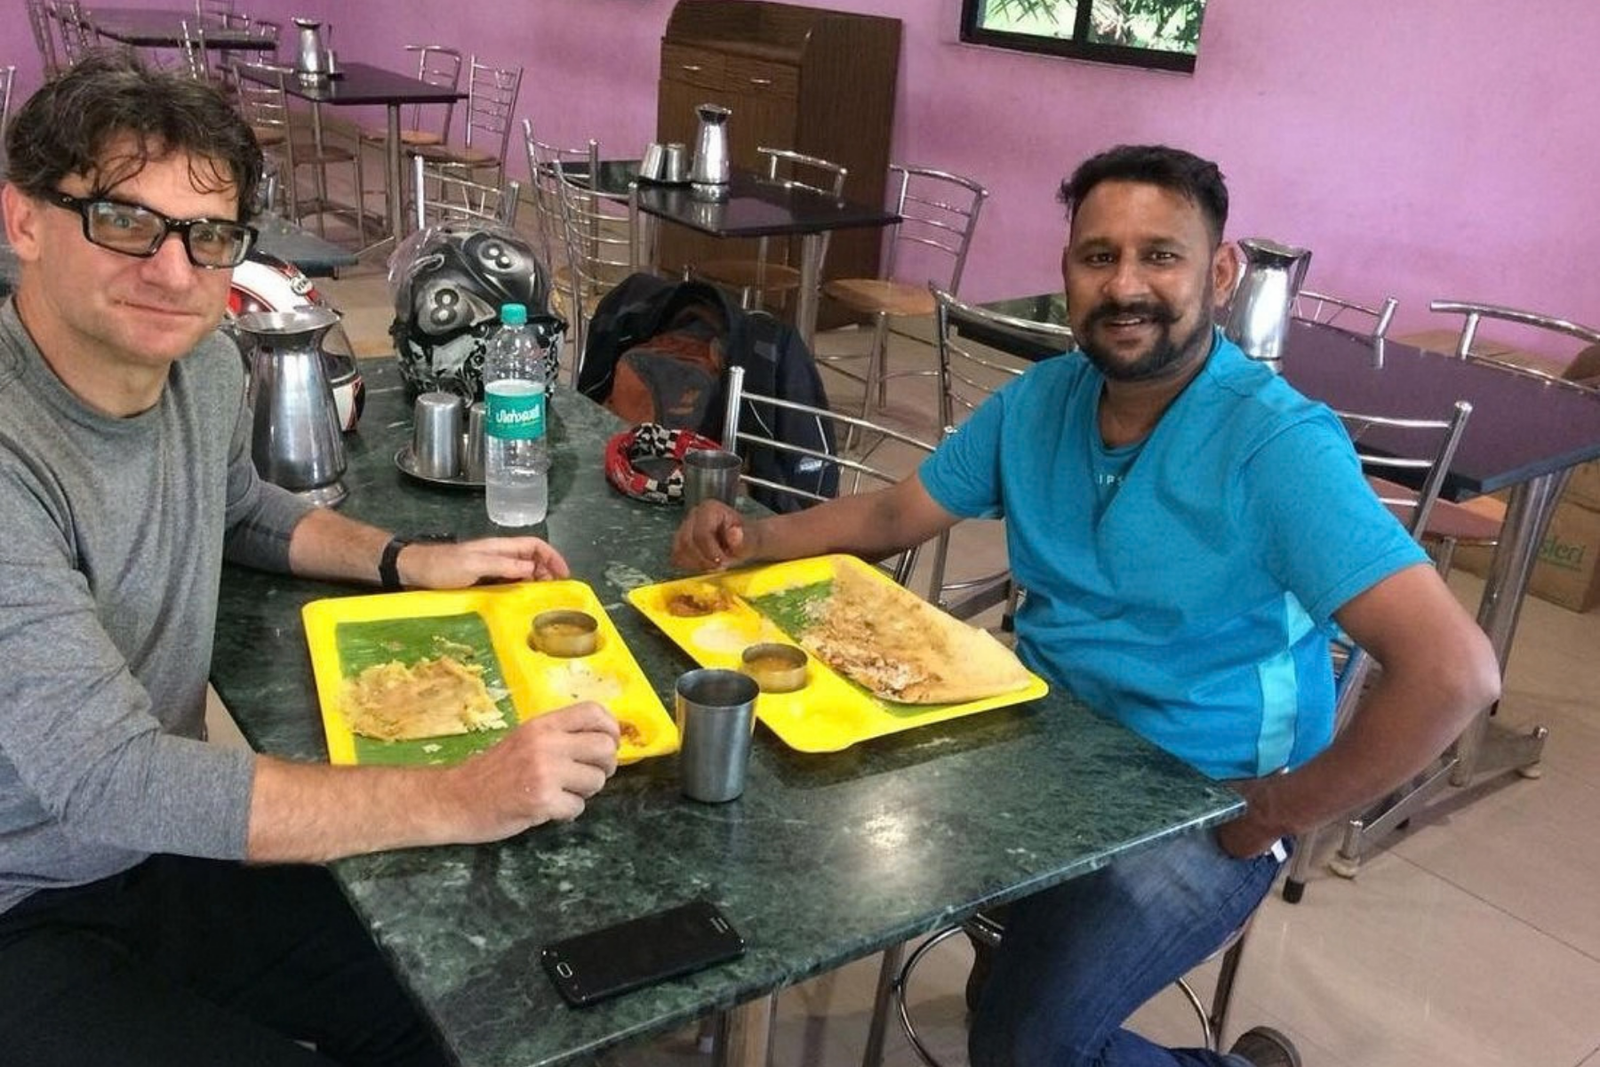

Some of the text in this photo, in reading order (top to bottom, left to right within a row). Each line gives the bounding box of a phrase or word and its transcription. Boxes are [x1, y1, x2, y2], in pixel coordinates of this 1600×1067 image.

[481, 242, 511, 269] 8
[430, 288, 460, 325] 8
[1539, 536, 1586, 564] sleri
